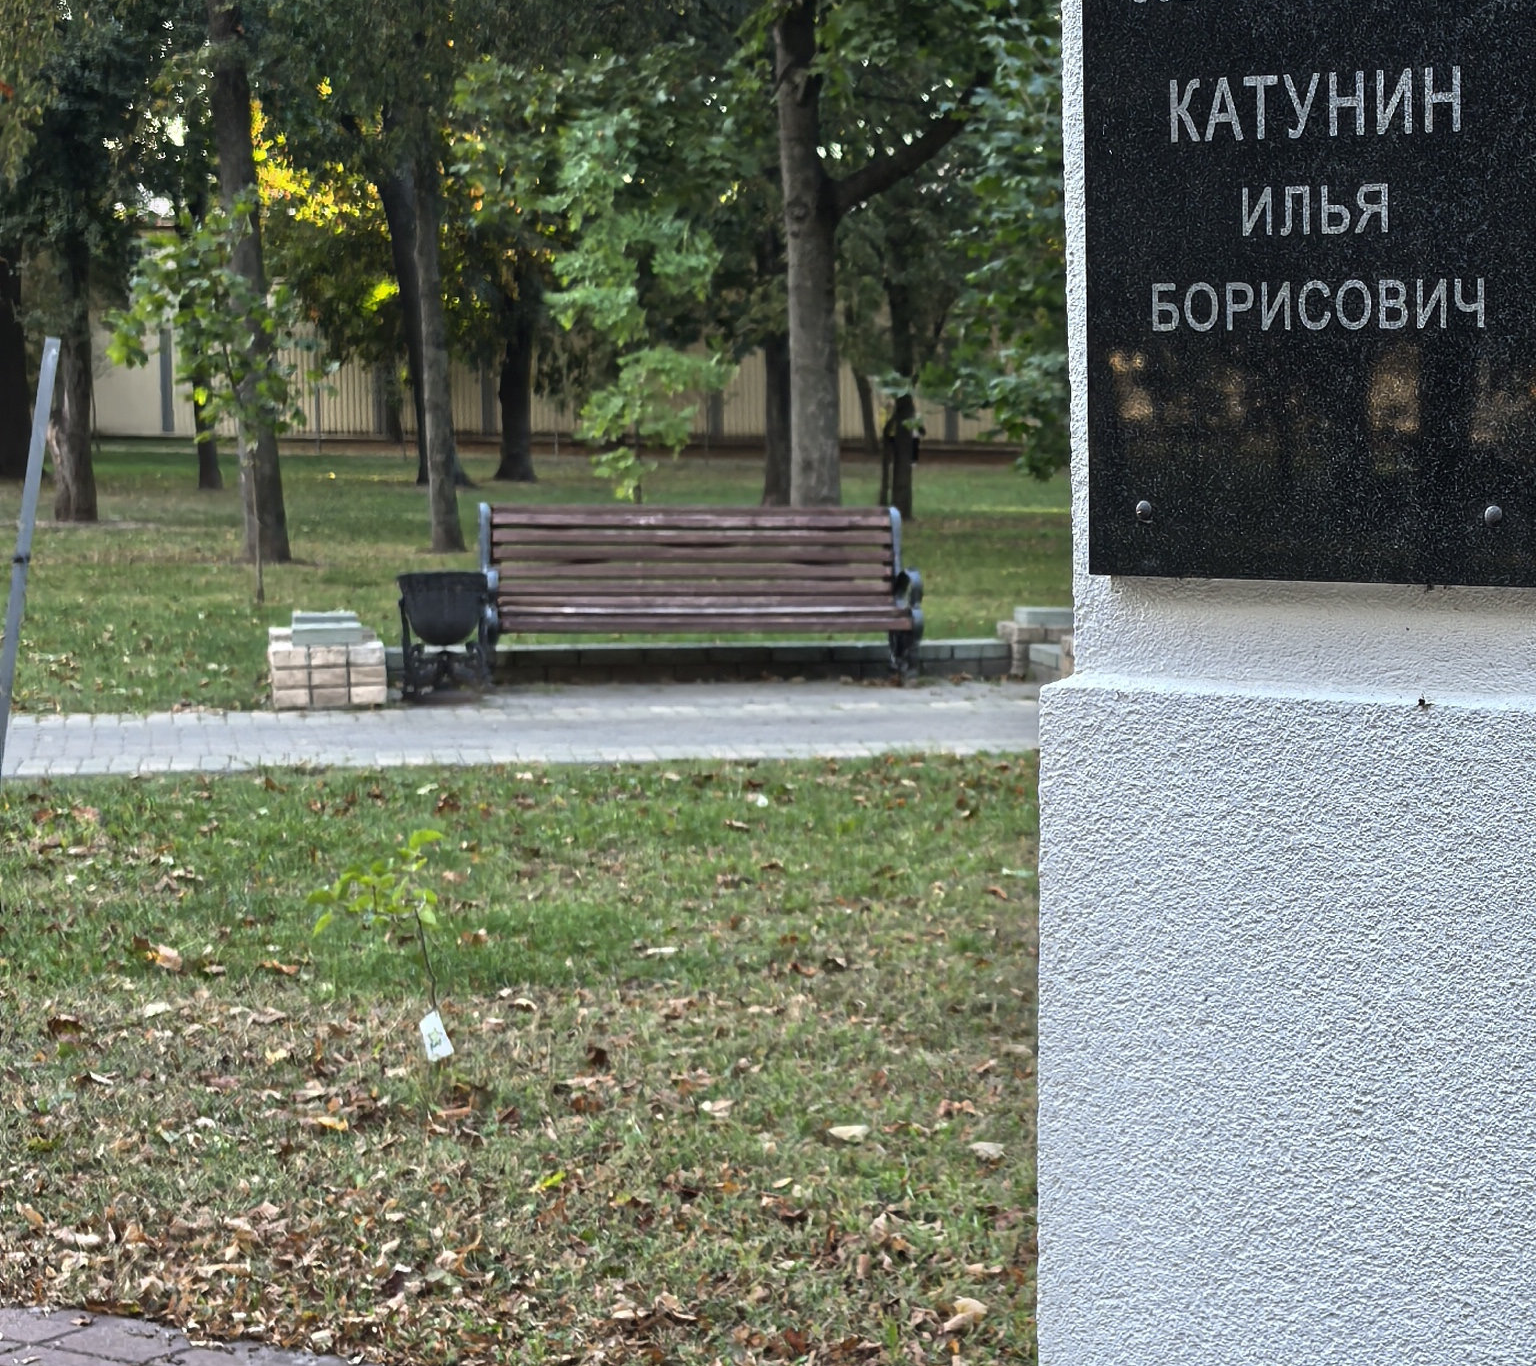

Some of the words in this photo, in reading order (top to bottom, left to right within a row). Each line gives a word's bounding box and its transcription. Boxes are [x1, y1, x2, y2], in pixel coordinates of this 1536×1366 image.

[1170, 66, 1461, 142] КАТУНИН
[1242, 183, 1388, 236] ИЛЬЯ
[1152, 278, 1485, 331] БОРИСОВИЧ
